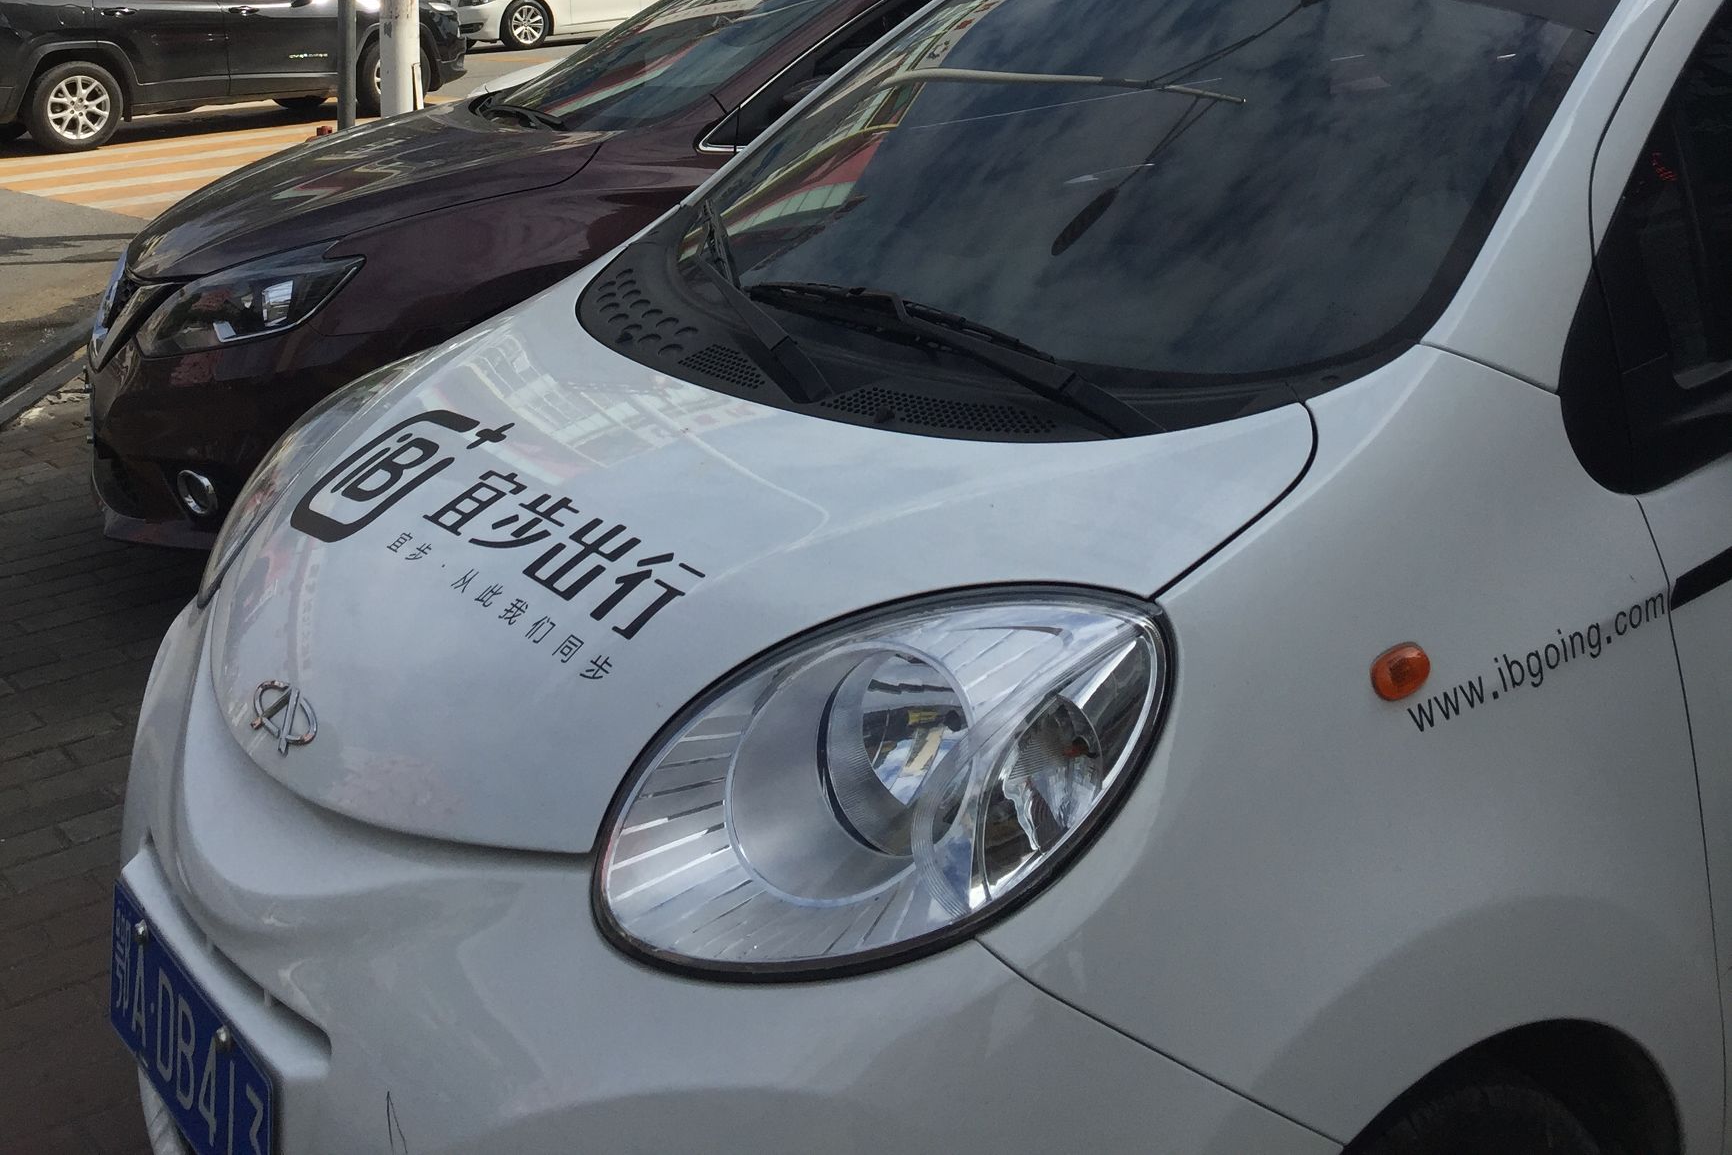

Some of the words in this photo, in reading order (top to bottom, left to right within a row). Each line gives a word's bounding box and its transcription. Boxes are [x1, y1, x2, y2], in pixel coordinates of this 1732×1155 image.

[423, 469, 706, 641] 宜步出行
[1407, 592, 1666, 732] www.ibgoing.com
